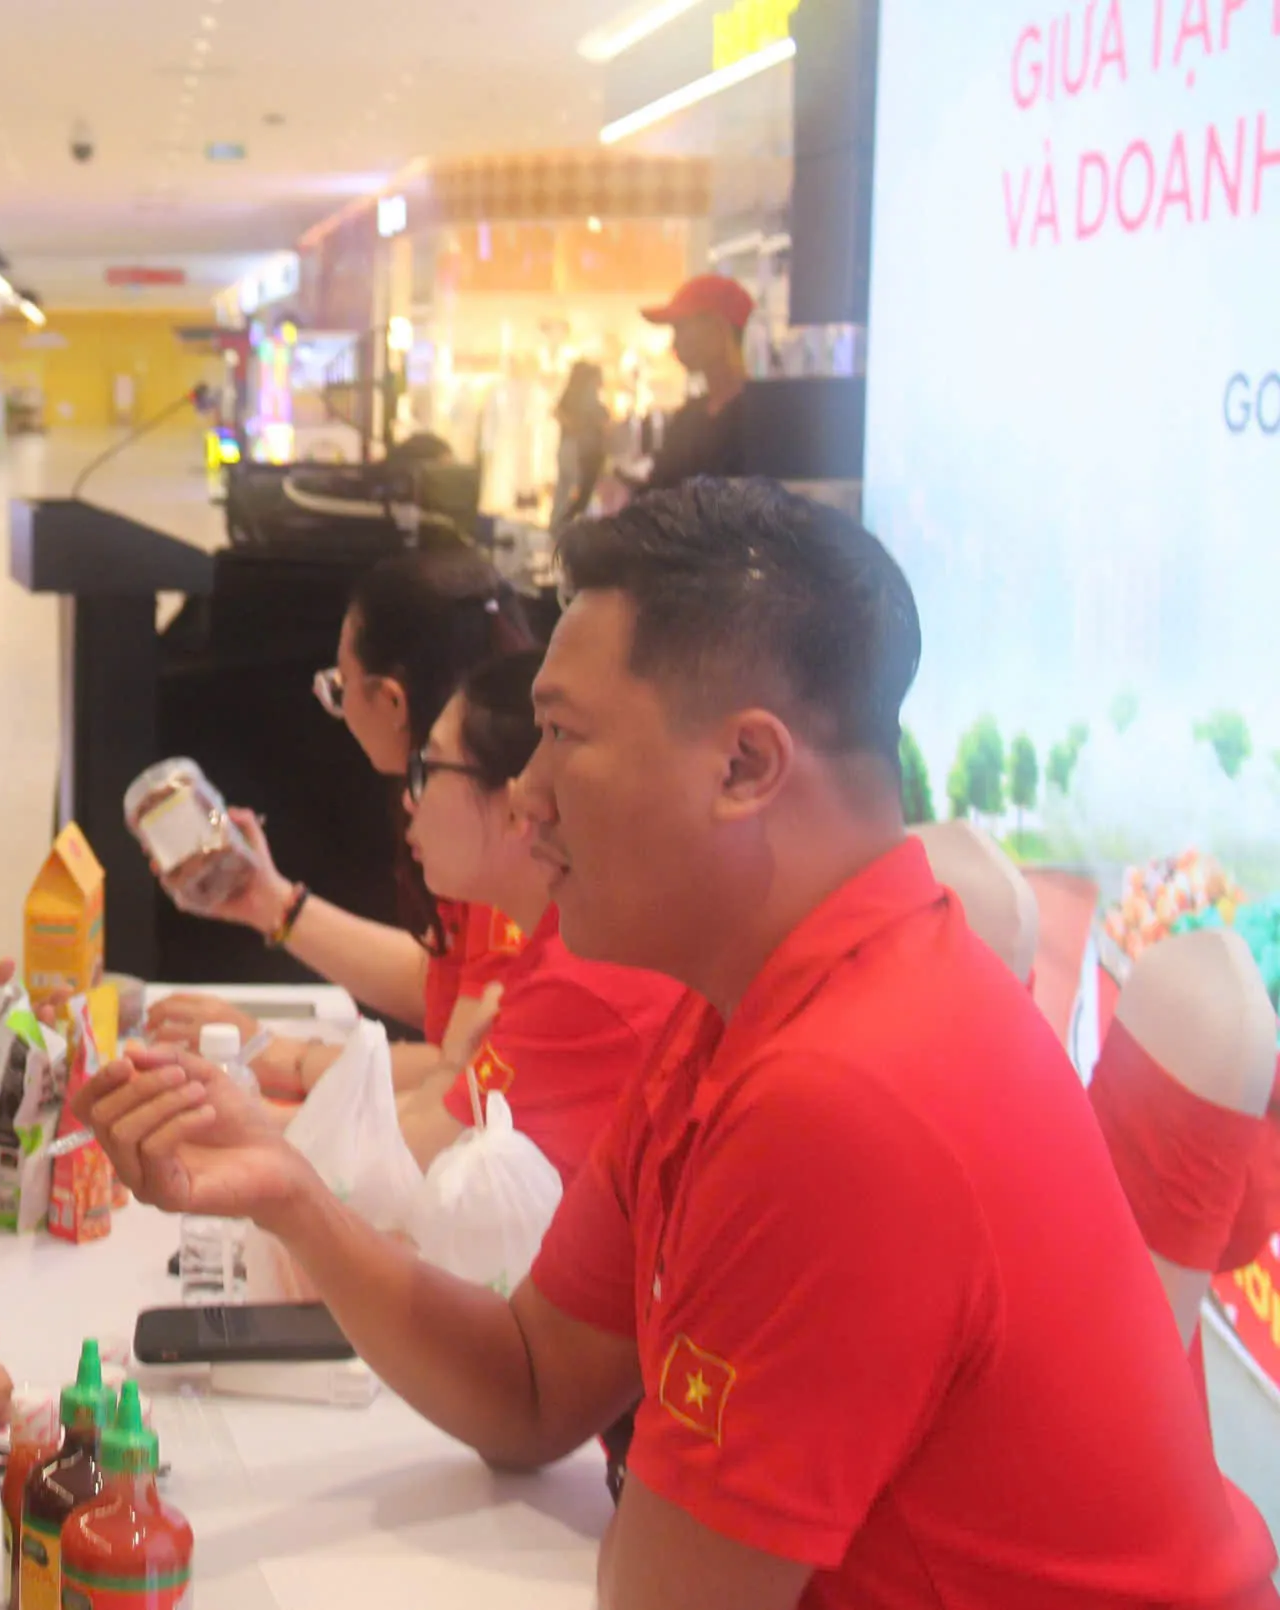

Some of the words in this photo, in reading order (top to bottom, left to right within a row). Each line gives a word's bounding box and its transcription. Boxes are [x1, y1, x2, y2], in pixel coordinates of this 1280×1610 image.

[1002, 137, 1061, 251] VÀ
[1076, 111, 1280, 240] DOANH
[1223, 370, 1280, 436] GO
